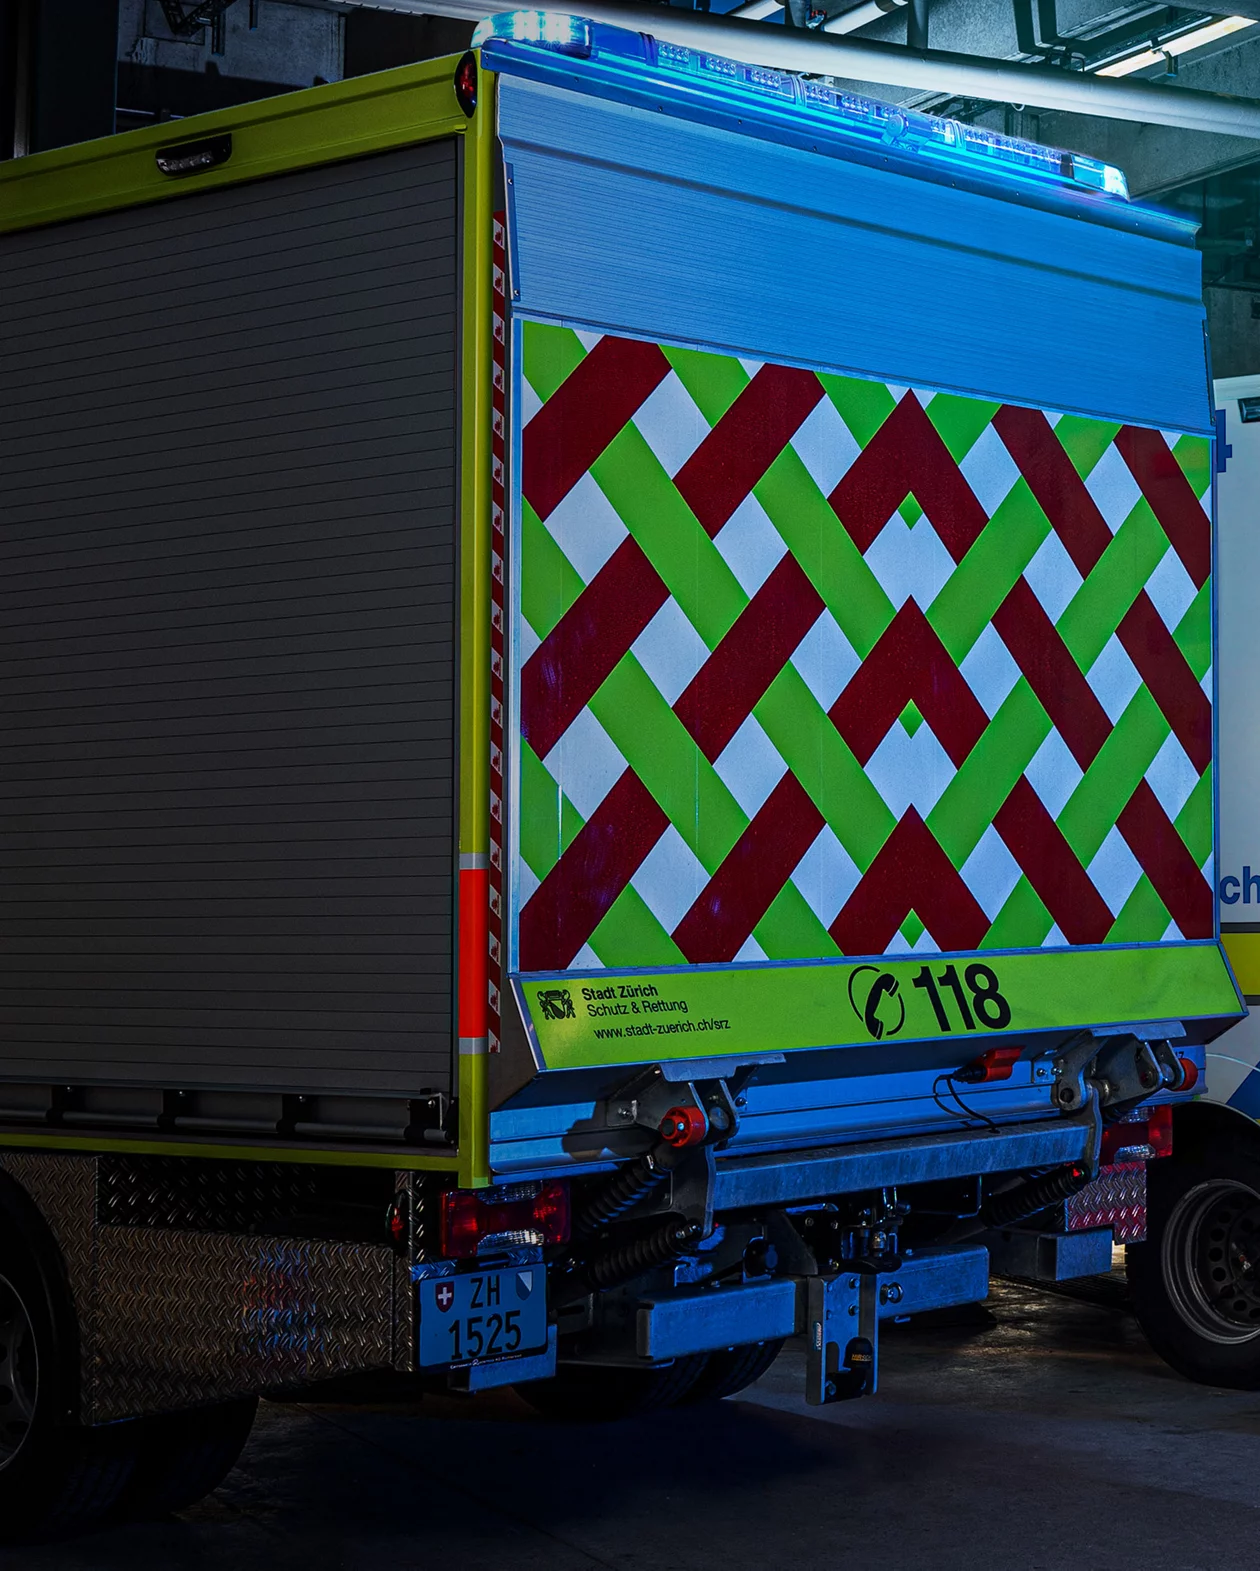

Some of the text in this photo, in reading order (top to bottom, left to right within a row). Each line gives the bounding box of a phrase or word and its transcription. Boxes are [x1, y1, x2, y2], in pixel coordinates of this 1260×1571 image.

[581, 984, 659, 1001] Stadt Zürich
[912, 963, 1012, 1033] 118
[586, 1000, 689, 1017] Schutz & Rettung
[593, 1018, 731, 1040] www.stadt-zuerich.ch/srz
[470, 1274, 500, 1310] ZH
[448, 1310, 522, 1361] 1525
